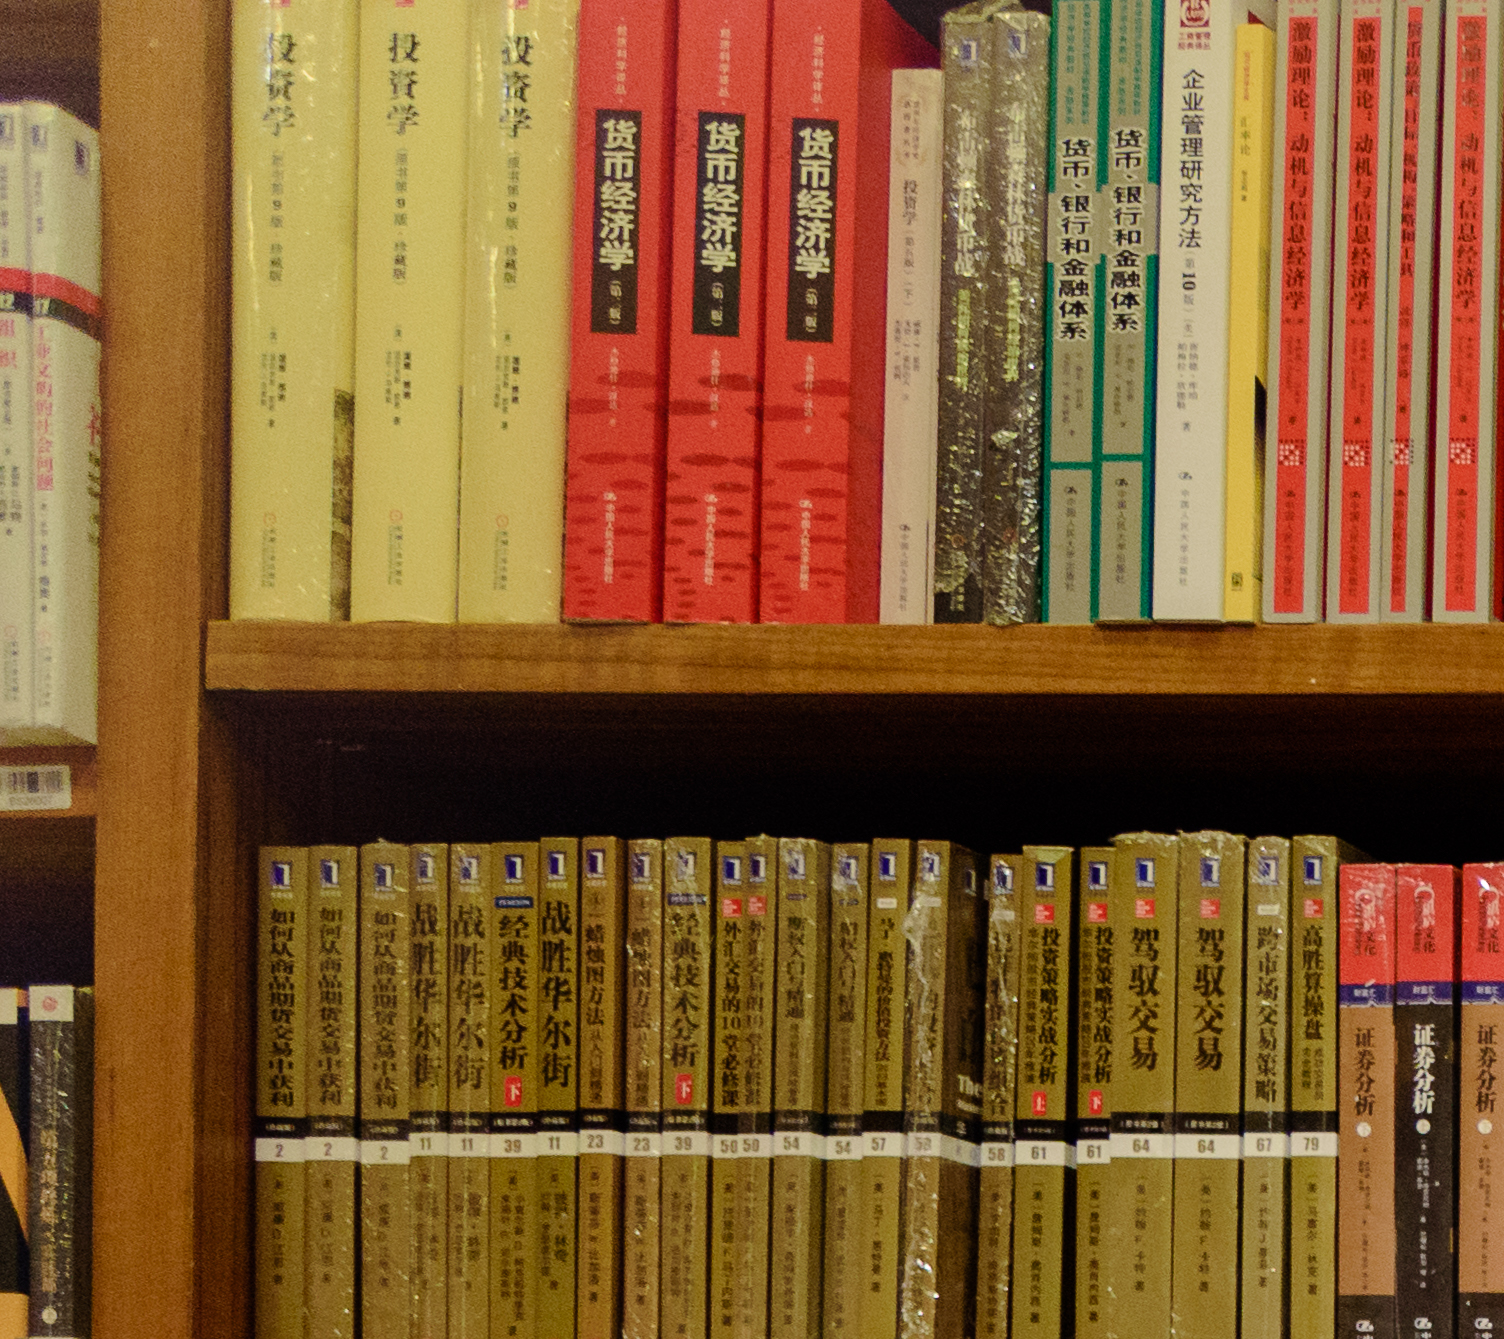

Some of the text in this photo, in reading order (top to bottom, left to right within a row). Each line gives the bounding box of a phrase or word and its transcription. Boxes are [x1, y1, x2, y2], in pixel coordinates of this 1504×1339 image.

[599, 118, 637, 273] 货币经济学
[1177, 68, 1205, 250] 企业管理研究方法
[1057, 139, 1093, 343] 货币、银行和金融体系
[497, 915, 529, 1070] 经典技术分析
[1413, 1024, 1435, 1116] 证券分析
